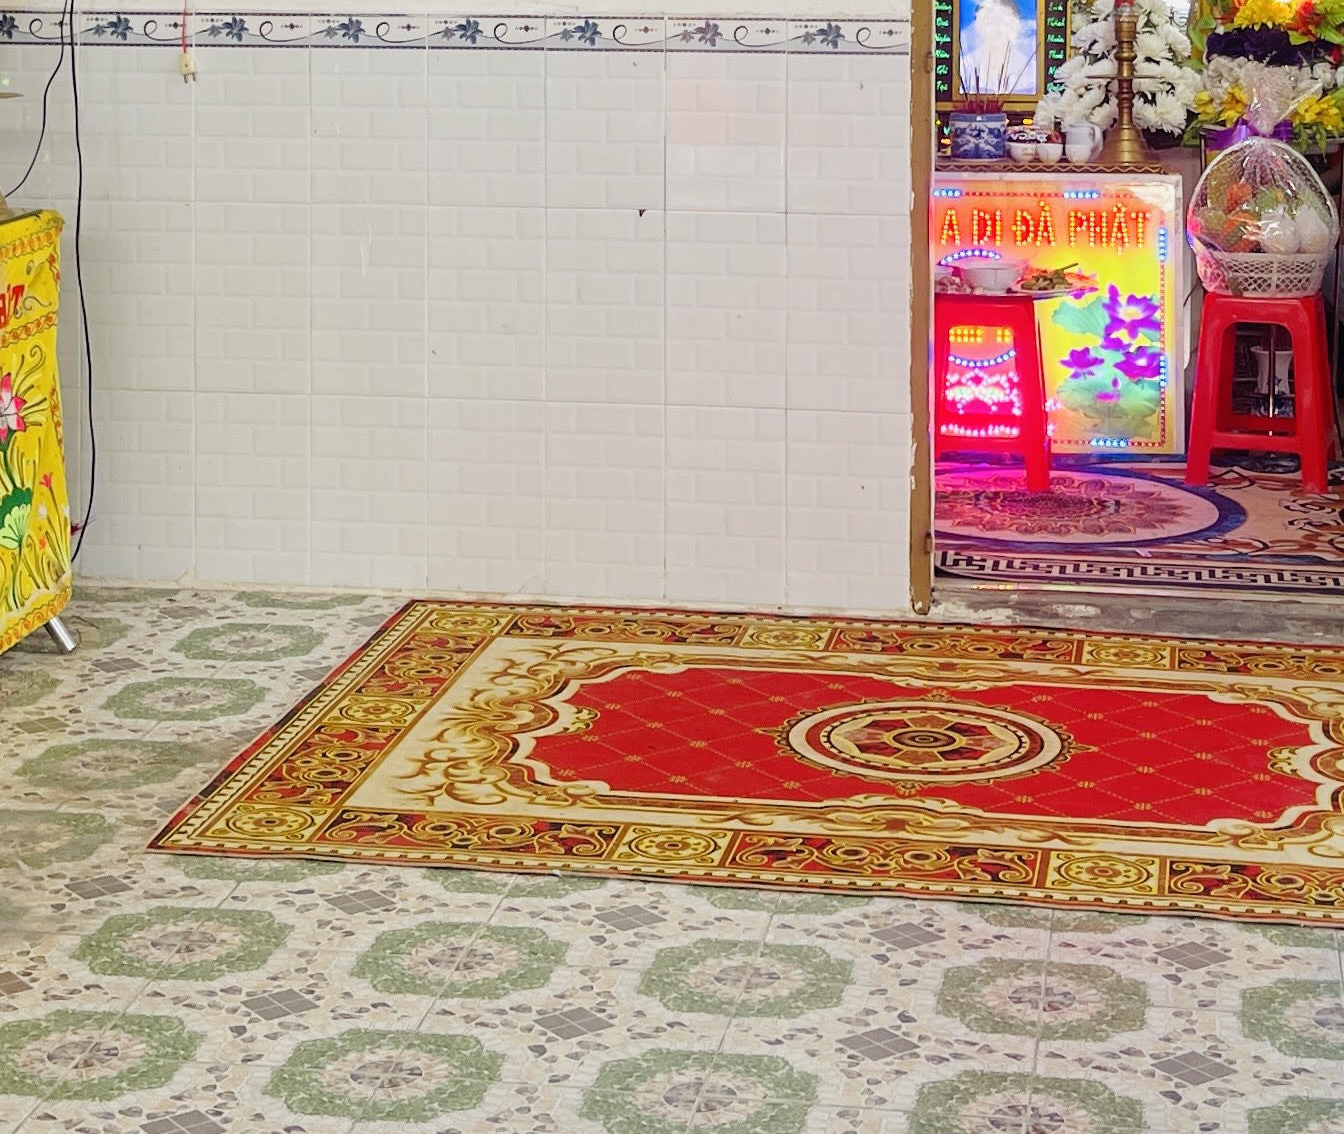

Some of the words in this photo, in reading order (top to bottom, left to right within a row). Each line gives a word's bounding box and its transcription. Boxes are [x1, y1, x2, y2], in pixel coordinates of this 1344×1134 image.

[940, 208, 960, 247] A
[971, 208, 1003, 247] DI
[1010, 199, 1057, 248] ĐÀ
[1068, 201, 1152, 256] PHẬT
